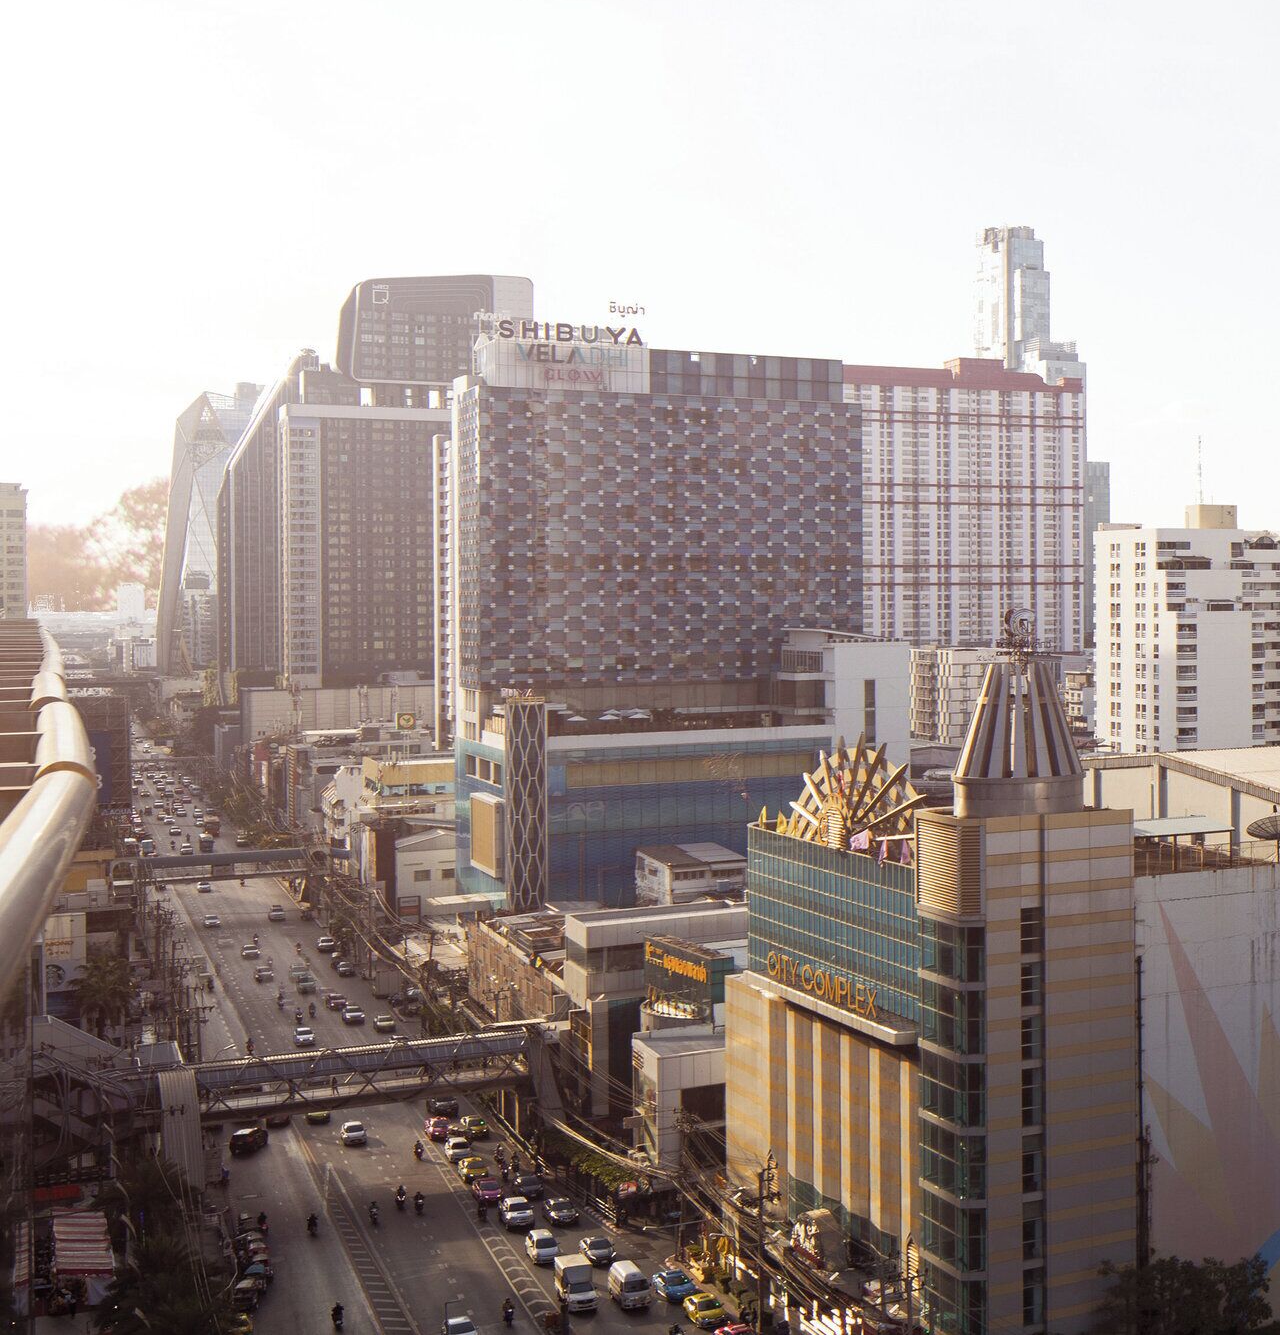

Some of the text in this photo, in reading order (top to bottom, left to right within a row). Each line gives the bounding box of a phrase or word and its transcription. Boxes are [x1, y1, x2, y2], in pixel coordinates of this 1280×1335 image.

[609, 301, 645, 318] ชิบูญ่า
[499, 320, 643, 346] SHIBUYA
[767, 951, 877, 1018] CITY COMPLEX
